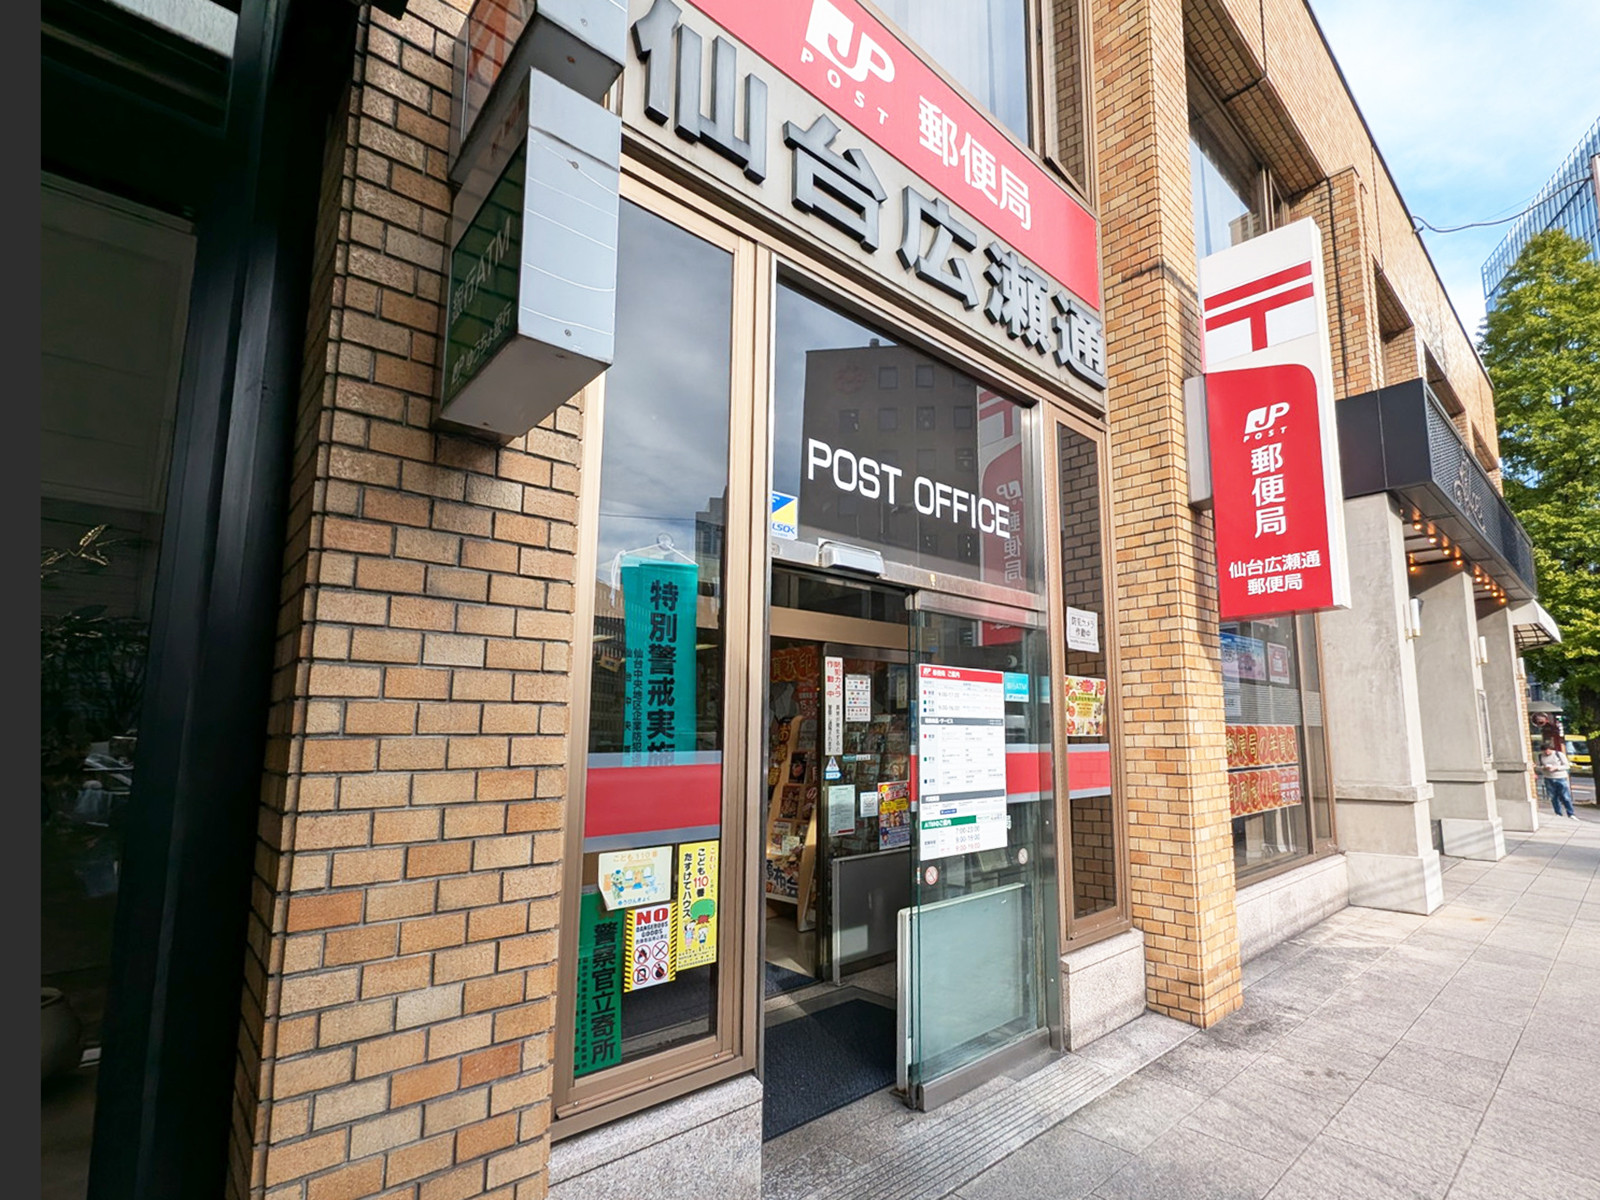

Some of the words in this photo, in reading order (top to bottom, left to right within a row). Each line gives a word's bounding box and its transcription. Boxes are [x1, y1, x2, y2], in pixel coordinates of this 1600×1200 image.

[801, 47, 890, 125] POST
[918, 95, 1032, 231] 郵便局
[631, 0, 1107, 389] 仙台広瀬通
[1243, 425, 1288, 443] POST
[808, 438, 902, 505] POST
[914, 476, 1010, 538] OFFICE
[1250, 442, 1287, 539] 郵便局
[1228, 549, 1321, 579] 仙台広瀬通
[1247, 572, 1303, 596] 郵便局
[826, 660, 834, 698] 作動中
[682, 852, 692, 918] たすけてハウス
[693, 848, 709, 898] こども110番
[636, 907, 669, 926] NO
[636, 921, 669, 933] DANGEROUS
[641, 928, 663, 938] GOODS
[590, 921, 618, 1065] 警察官立寄所
